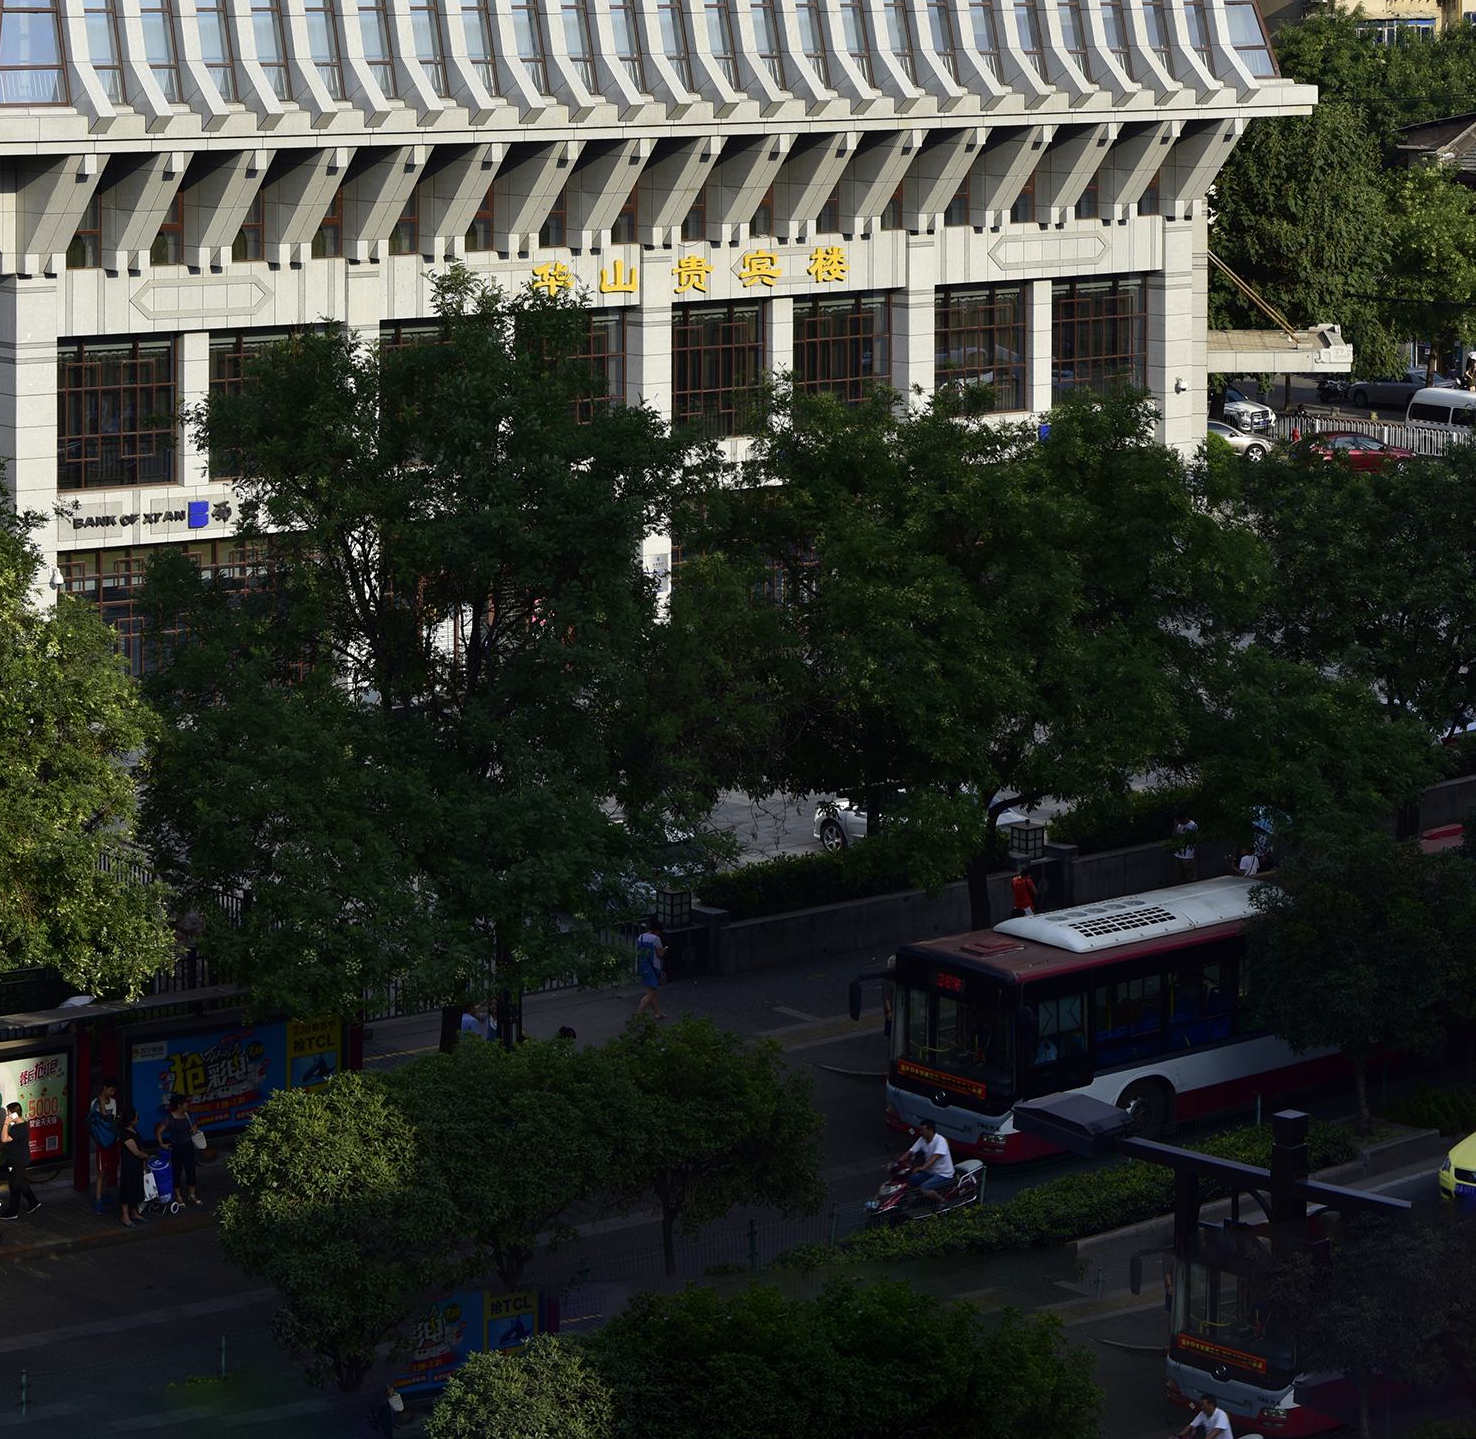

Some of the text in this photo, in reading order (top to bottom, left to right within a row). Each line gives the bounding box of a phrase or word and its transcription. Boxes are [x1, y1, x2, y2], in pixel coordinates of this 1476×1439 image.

[532, 246, 851, 297] 华山贵宾楼
[73, 514, 118, 530] BANK
[119, 513, 141, 528] OF
[293, 1034, 335, 1053] 抢TCL
